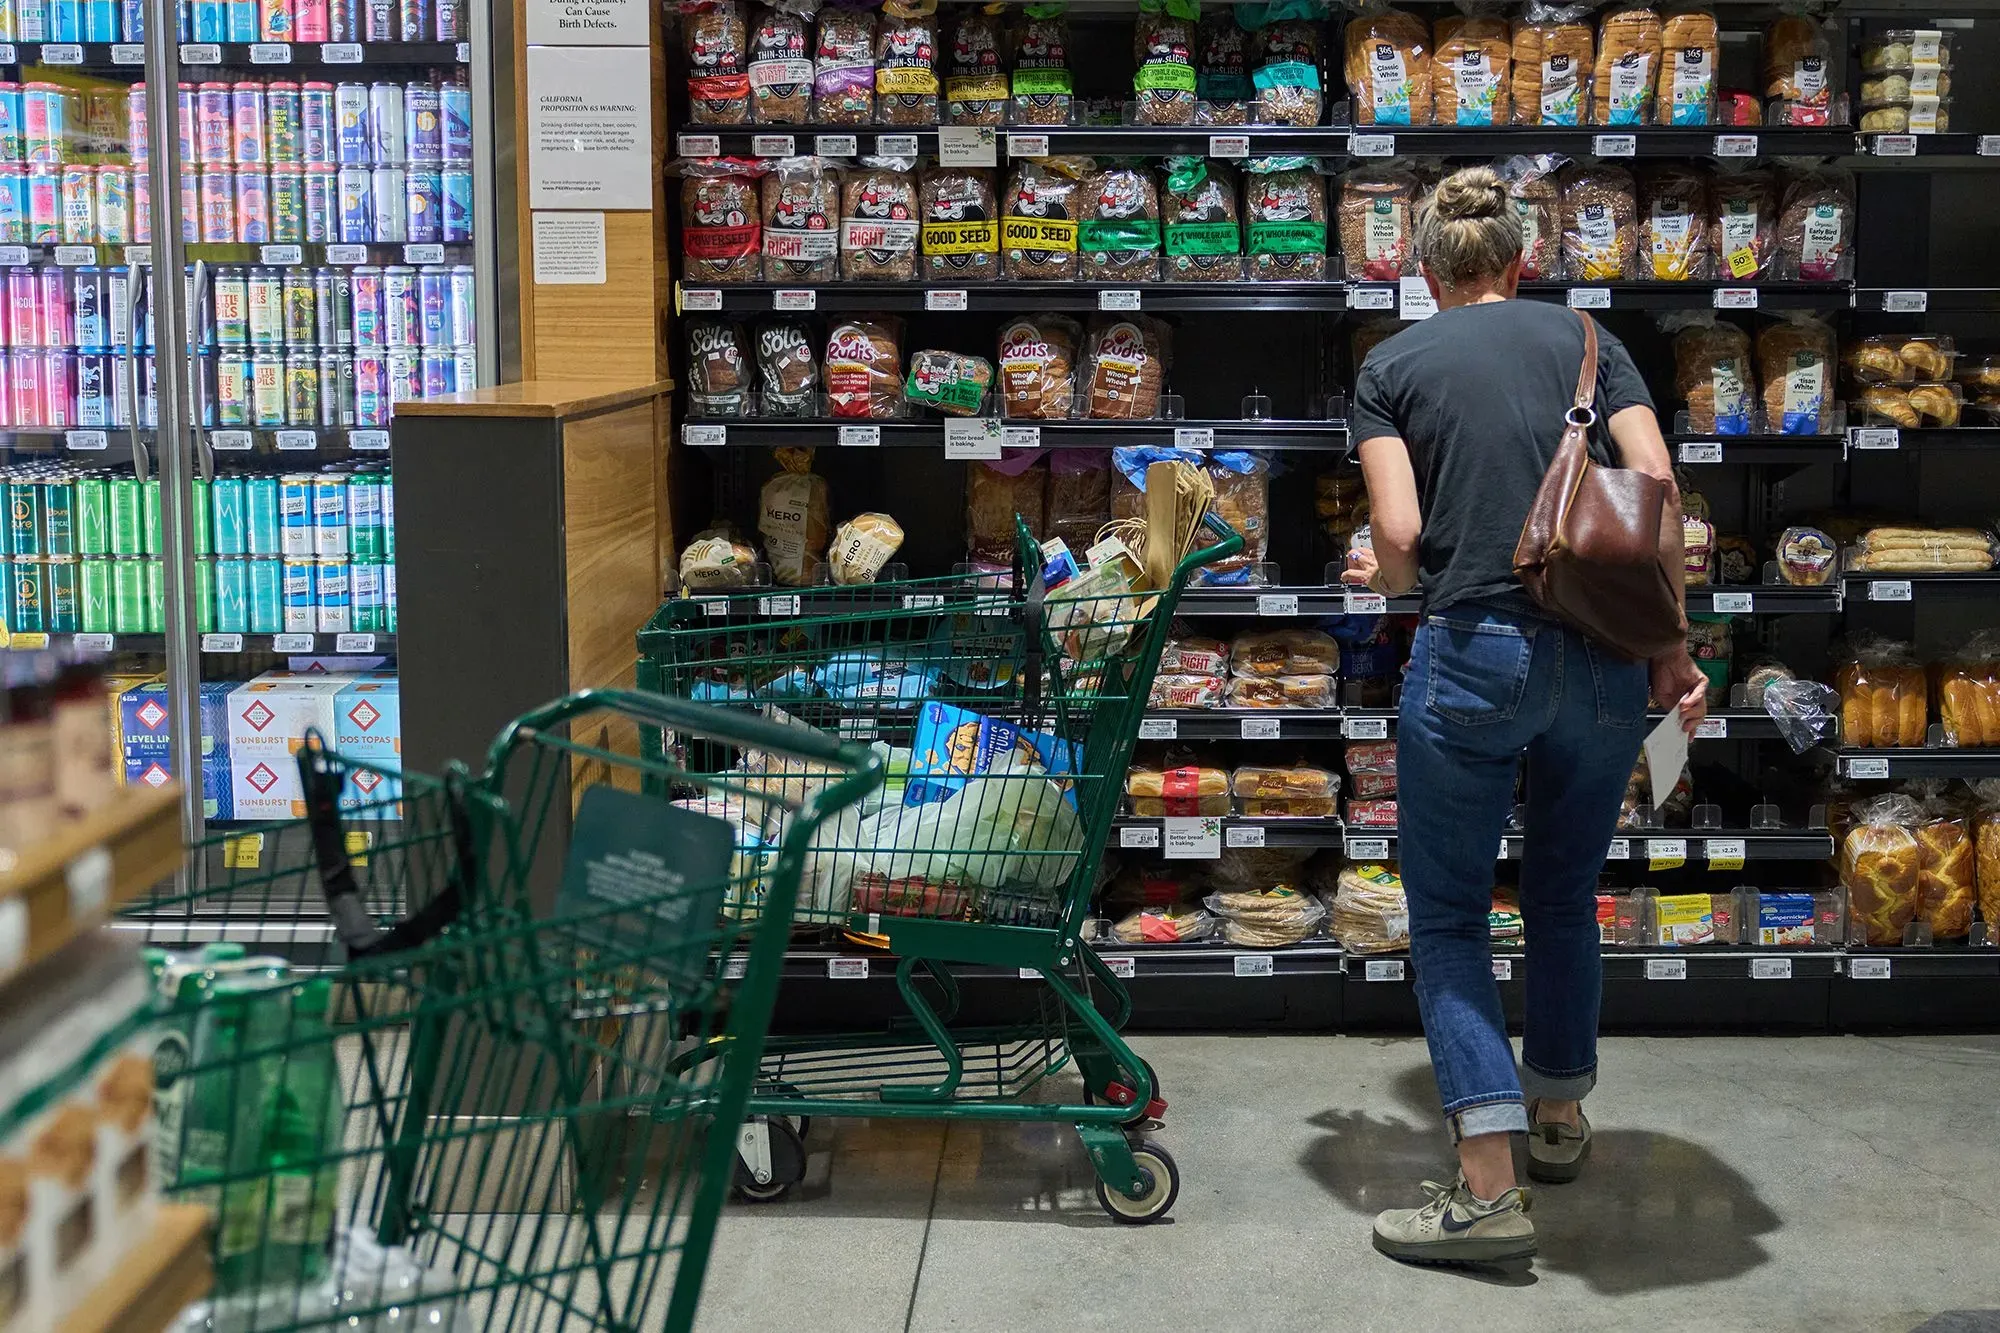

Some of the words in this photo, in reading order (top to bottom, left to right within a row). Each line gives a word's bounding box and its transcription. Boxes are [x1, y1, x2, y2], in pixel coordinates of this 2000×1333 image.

[565, 7, 582, 16] Can
[584, 7, 610, 16] Cause
[559, 19, 581, 28] Birth
[583, 19, 617, 28] Defects.
[920, 46, 931, 55] 70
[1378, 46, 1393, 56] 365
[1685, 49, 1701, 58] 365
[1146, 55, 1188, 65] THIN-SLICED
[1464, 52, 1480, 61] 365
[1019, 59, 1065, 68] THIN-SLICED
[1552, 57, 1568, 66] 365
[1804, 58, 1820, 66] 365
[690, 67, 738, 78] THIN-SLICED
[952, 65, 997, 75] THIN-SLICED
[1377, 64, 1399, 72] Classic
[1460, 69, 1483, 77] Classic
[1376, 200, 1391, 209] 365
[1586, 205, 1602, 215] 365
[1660, 218, 1680, 226] Honey
[1741, 222, 1754, 230] Bird
[926, 231, 957, 245] GOOD
[959, 229, 991, 243] SEED
[1007, 224, 1037, 238] GOOD
[1040, 227, 1071, 242] SEED
[1253, 232, 1265, 244] 21
[1266, 230, 1288, 238] WHOLE
[1809, 228, 1824, 237] Early
[688, 233, 751, 246] POWERSEED
[850, 232, 886, 246] RIGHT
[1171, 232, 1185, 246] 21
[768, 243, 802, 257] RIGHT
[1410, 300, 1431, 308] baking.
[690, 325, 735, 357] Sola
[762, 325, 807, 358] Sola
[828, 340, 874, 361] Rudi's
[1002, 339, 1048, 359] Rudi's
[1098, 338, 1147, 361] Rudi's
[833, 365, 864, 373] ORGANIC
[1103, 362, 1134, 372] ORGANIC
[832, 373, 849, 381] Honey
[1106, 370, 1128, 378] Whole
[1105, 377, 1127, 386] Wheat
[1794, 383, 1814, 391] White
[942, 388, 957, 401] 21
[968, 434, 984, 442] bread
[768, 507, 802, 522] HERO
[844, 539, 861, 568] HERO
[694, 569, 721, 579] HERO
[1219, 575, 1239, 583] WHITE
[1699, 648, 1710, 656] 27
[1180, 656, 1210, 671] RIGHT
[1171, 690, 1199, 704] RIGHT
[127, 735, 159, 744] LEVEL
[235, 736, 284, 744] SUNBURST
[340, 736, 360, 744] DOS
[362, 736, 390, 744] TOPAS
[239, 799, 287, 807] SUNBURST
[1175, 840, 1195, 848] baking.
[1765, 914, 1807, 923] Pumpernickel
